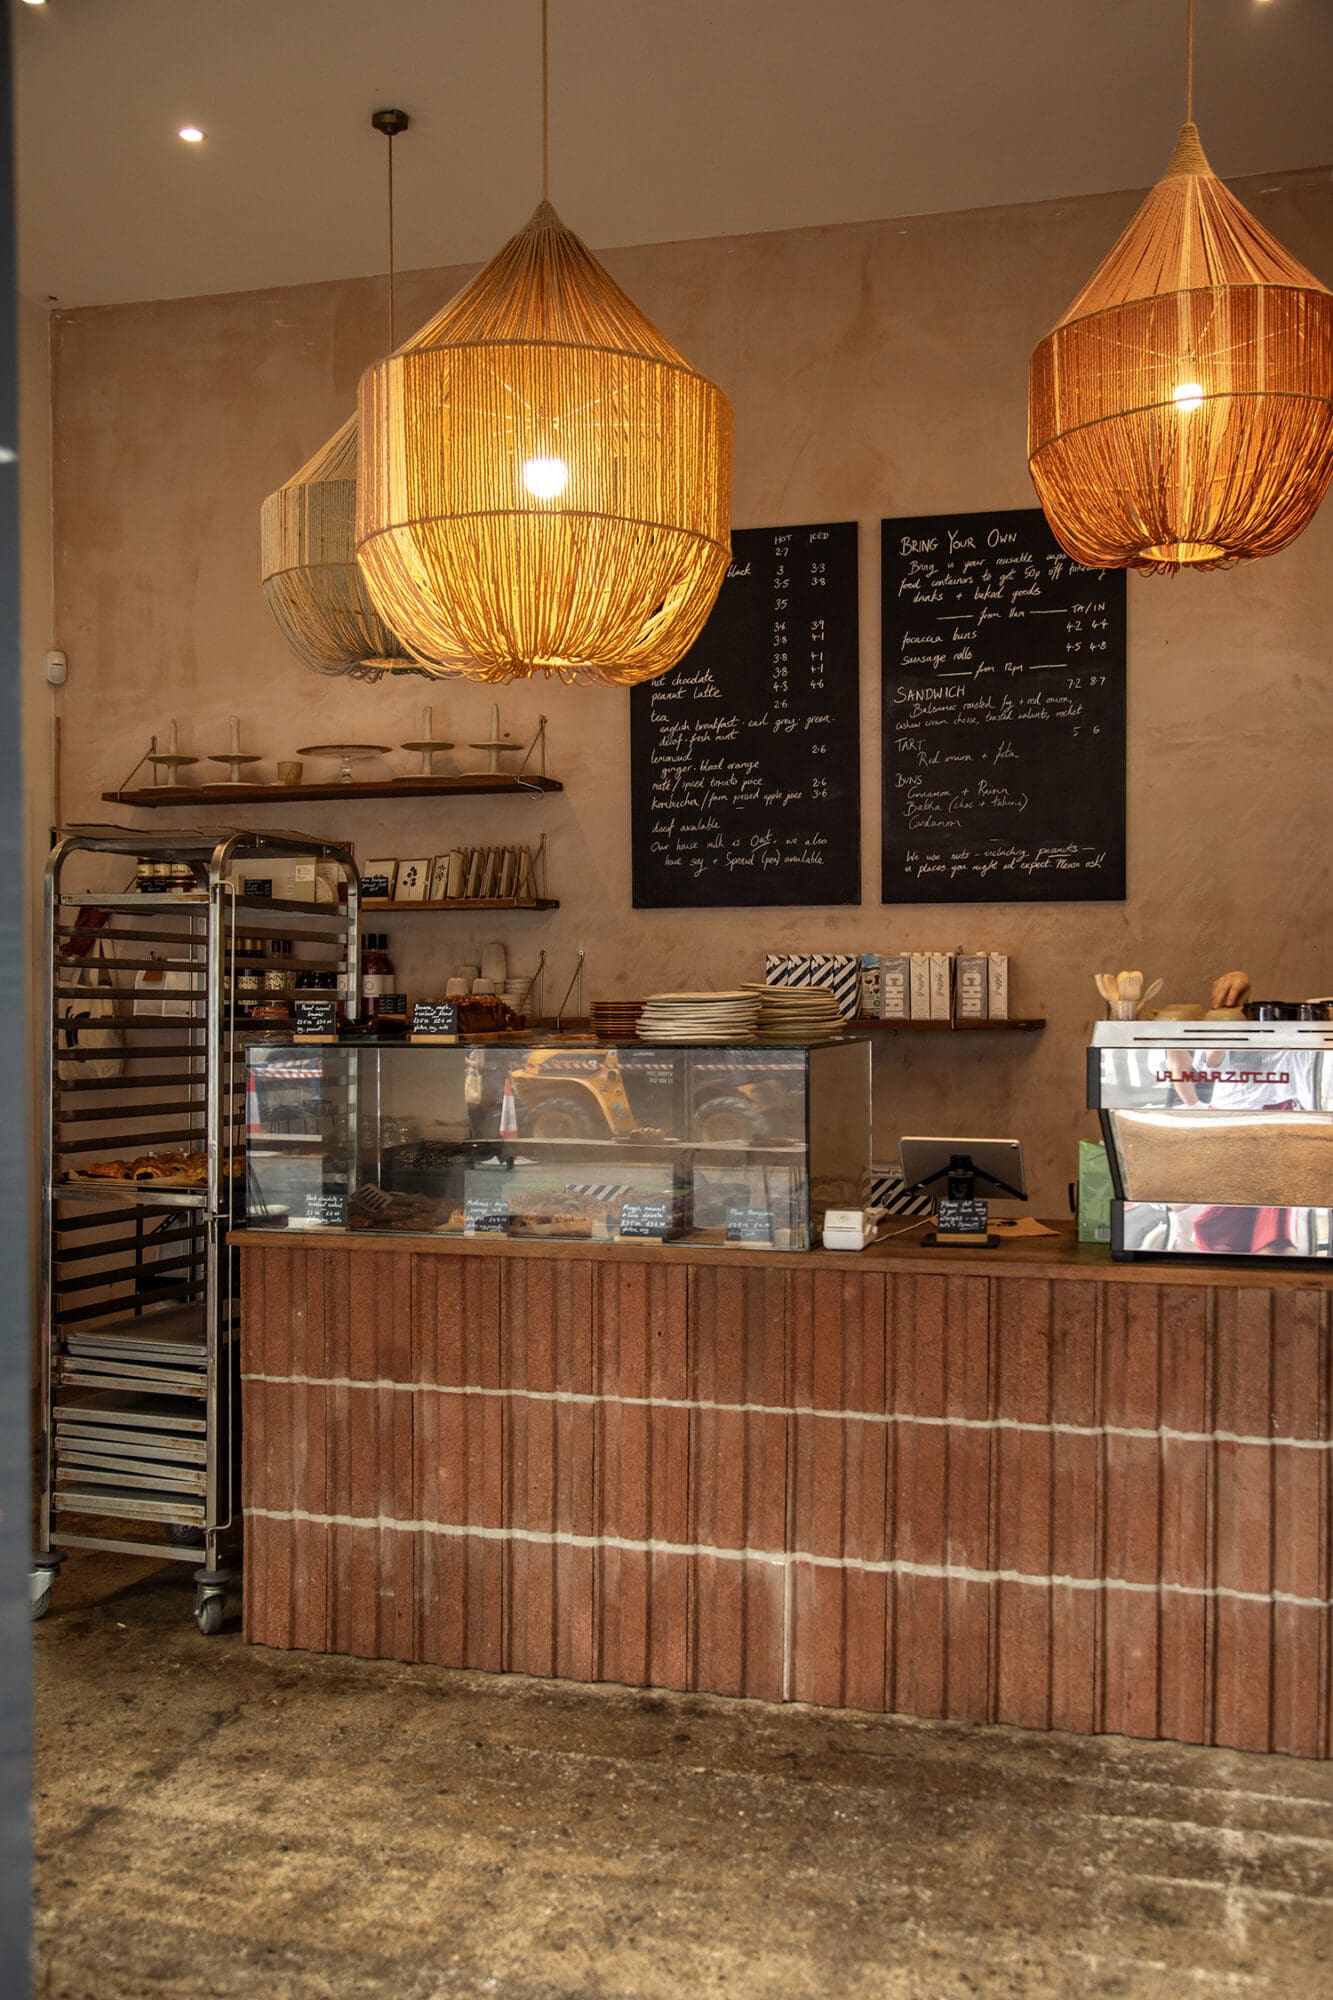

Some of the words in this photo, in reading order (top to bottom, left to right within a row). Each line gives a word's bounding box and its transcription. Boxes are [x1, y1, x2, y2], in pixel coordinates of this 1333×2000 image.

[774, 534, 792, 545] HOT
[809, 532, 829, 543] ICED
[899, 536, 939, 556] BRING
[947, 529, 976, 554] YOUR
[987, 528, 1017, 548] OWN
[726, 562, 751, 578] black
[907, 560, 939, 578] Bring
[962, 559, 986, 574] your
[996, 552, 1033, 565] reusable
[898, 577, 922, 597] food
[931, 573, 974, 587] containers
[982, 569, 992, 582] to
[999, 568, 1016, 587] get
[1048, 562, 1064, 580] off
[913, 589, 944, 603] drinks
[974, 584, 1005, 600] baked
[1011, 582, 1041, 604] goods
[977, 606, 1001, 626] from
[901, 631, 943, 651] focaccia
[952, 626, 977, 641] buns
[900, 654, 947, 669] sausage
[953, 646, 973, 660] rolls
[651, 674, 667, 687] hot
[671, 668, 715, 686] chocolate
[974, 661, 995, 680] from
[1004, 662, 1023, 677] 12pm
[651, 687, 687, 707] peanut
[693, 684, 723, 699] latte
[893, 684, 966, 704] SANDWICH
[909, 702, 957, 718] Balsamic
[963, 695, 995, 710] roasted
[1027, 691, 1042, 705] red
[650, 709, 670, 723] tea
[660, 720, 691, 739] english
[695, 715, 740, 734] breakfast
[747, 712, 769, 727] earl
[895, 719, 921, 731] cashew
[925, 718, 949, 727] cream
[985, 710, 1014, 722] toasted
[1056, 704, 1084, 717] rocket
[659, 733, 684, 751] decaf
[689, 731, 711, 749] fresh
[714, 728, 740, 741] mint
[894, 737, 927, 753] TART
[917, 750, 941, 767] Red
[944, 754, 974, 763] onion
[993, 740, 1020, 767] feta
[700, 757, 723, 772] blood
[727, 760, 760, 775] orange
[682, 776, 705, 791] spiced
[710, 772, 738, 787] tomato
[741, 777, 763, 792] juice
[895, 773, 923, 788] BUNS
[907, 786, 952, 799] Cinnamon
[978, 779, 1009, 797] Raisin
[650, 791, 700, 811] kombucha
[707, 791, 728, 808] farm
[732, 788, 760, 804] pressed
[763, 789, 782, 807] apple
[782, 790, 803, 807] juice
[652, 817, 676, 838] decaf
[680, 816, 720, 832] available
[650, 841, 670, 853] Our
[676, 838, 699, 851] house
[706, 833, 725, 849] milk
[731, 839, 741, 847] is
[785, 837, 798, 845] we
[804, 832, 828, 846] also
[906, 850, 920, 862] We
[926, 853, 941, 861] use
[950, 849, 971, 860] nuts
[983, 846, 1030, 863] including
[1034, 842, 1079, 861] peanuts
[664, 854, 683, 866] have
[689, 858, 708, 878] soy
[784, 849, 825, 864] available
[916, 863, 946, 879] places
[950, 864, 968, 879] you
[972, 860, 998, 878] might
[1055, 858, 1081, 869] Please
[1156, 1071, 1173, 1082] LA
[1181, 1071, 1290, 1084] MARZOCCO
